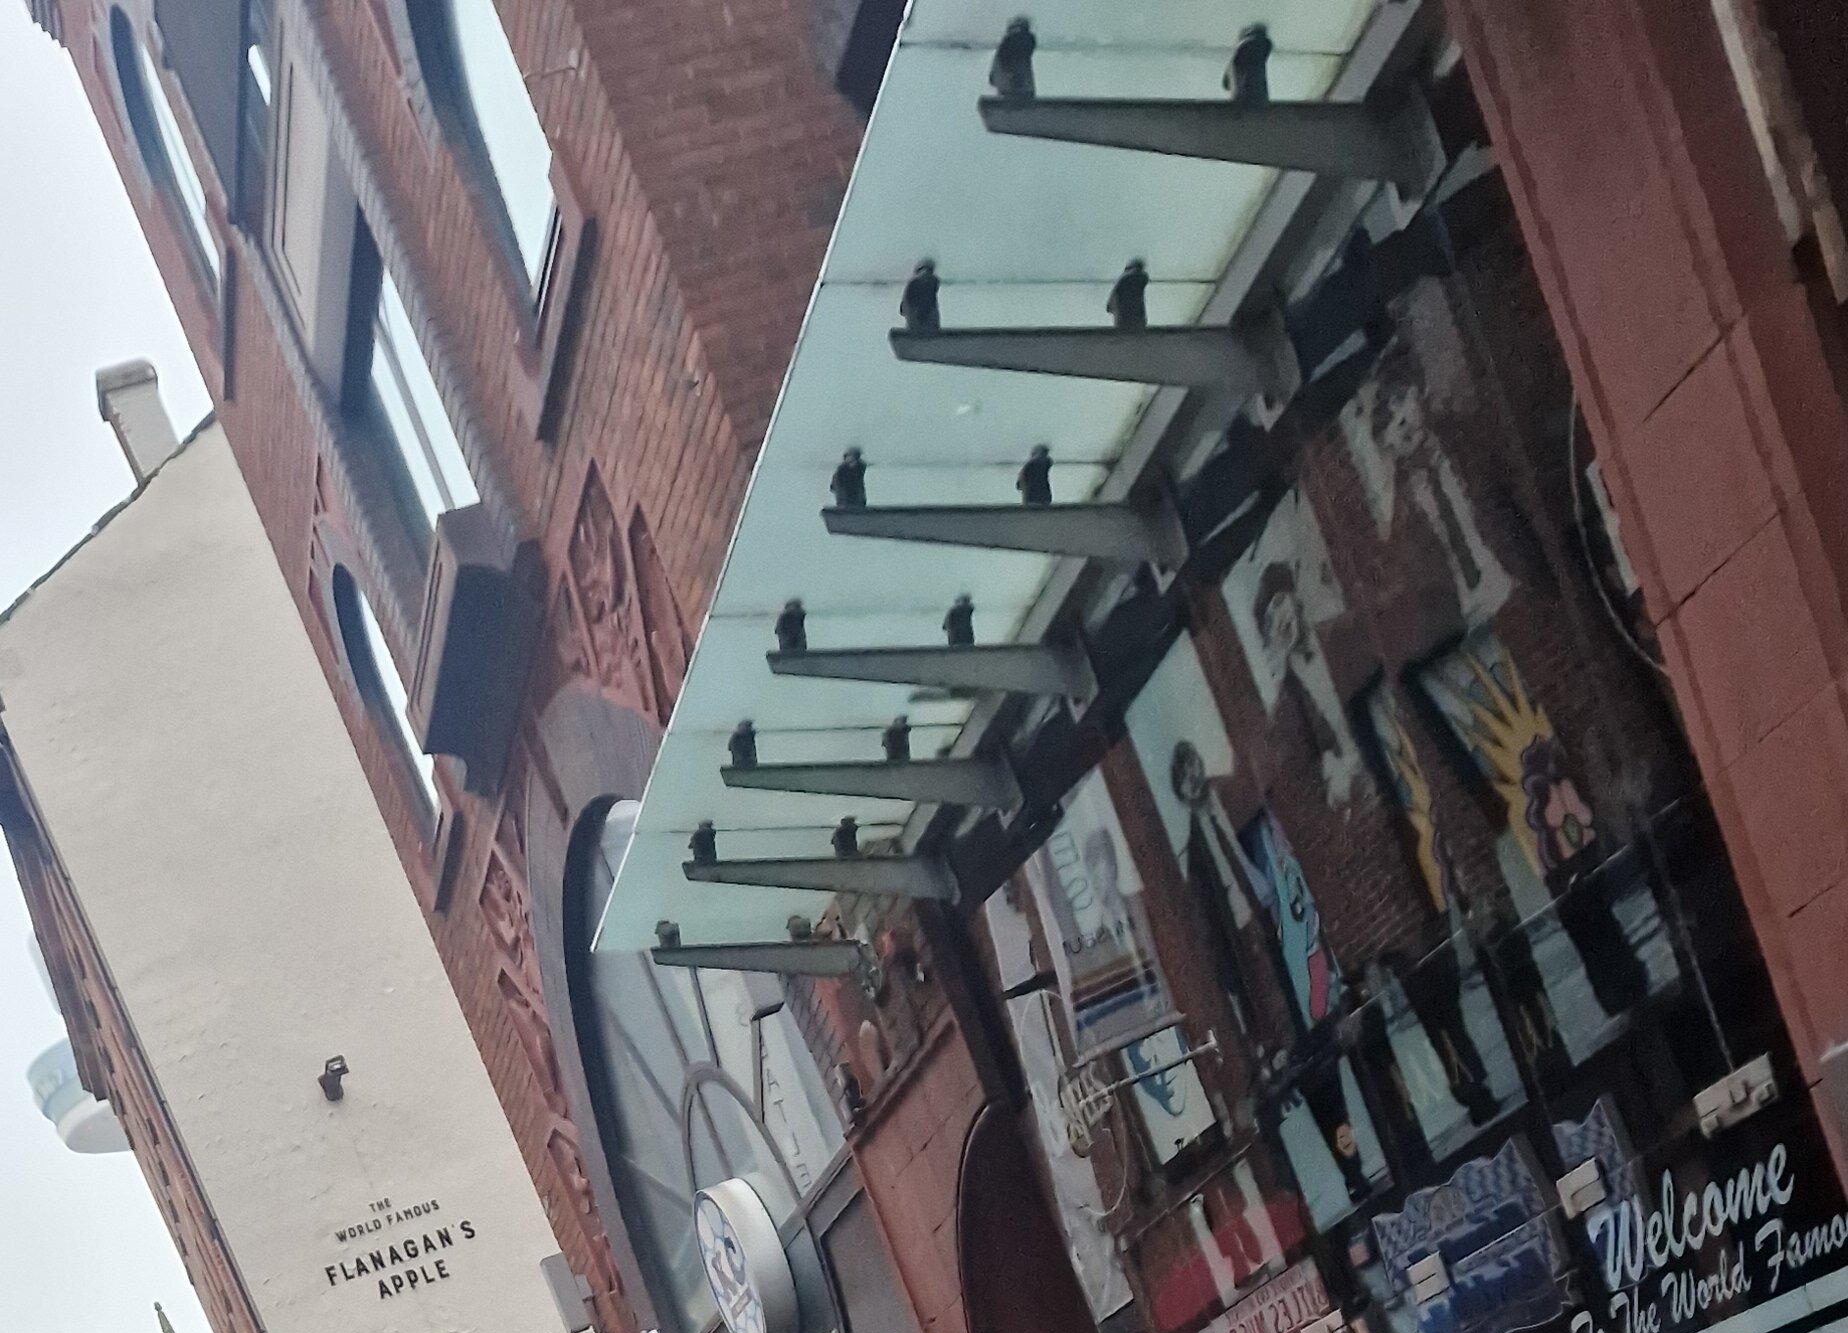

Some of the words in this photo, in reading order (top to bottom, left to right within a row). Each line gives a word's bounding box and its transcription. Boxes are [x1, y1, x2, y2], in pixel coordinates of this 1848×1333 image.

[335, 1218, 382, 1243] WORLD
[386, 1199, 440, 1226] FAMOUS
[368, 1197, 392, 1213] THE
[1587, 1143, 1795, 1291] Welcome
[324, 1220, 476, 1286] FLANAGAN'S
[378, 1259, 450, 1300] APPLE
[1661, 1241, 1752, 1324] World
[1755, 1212, 1848, 1293] Famo
